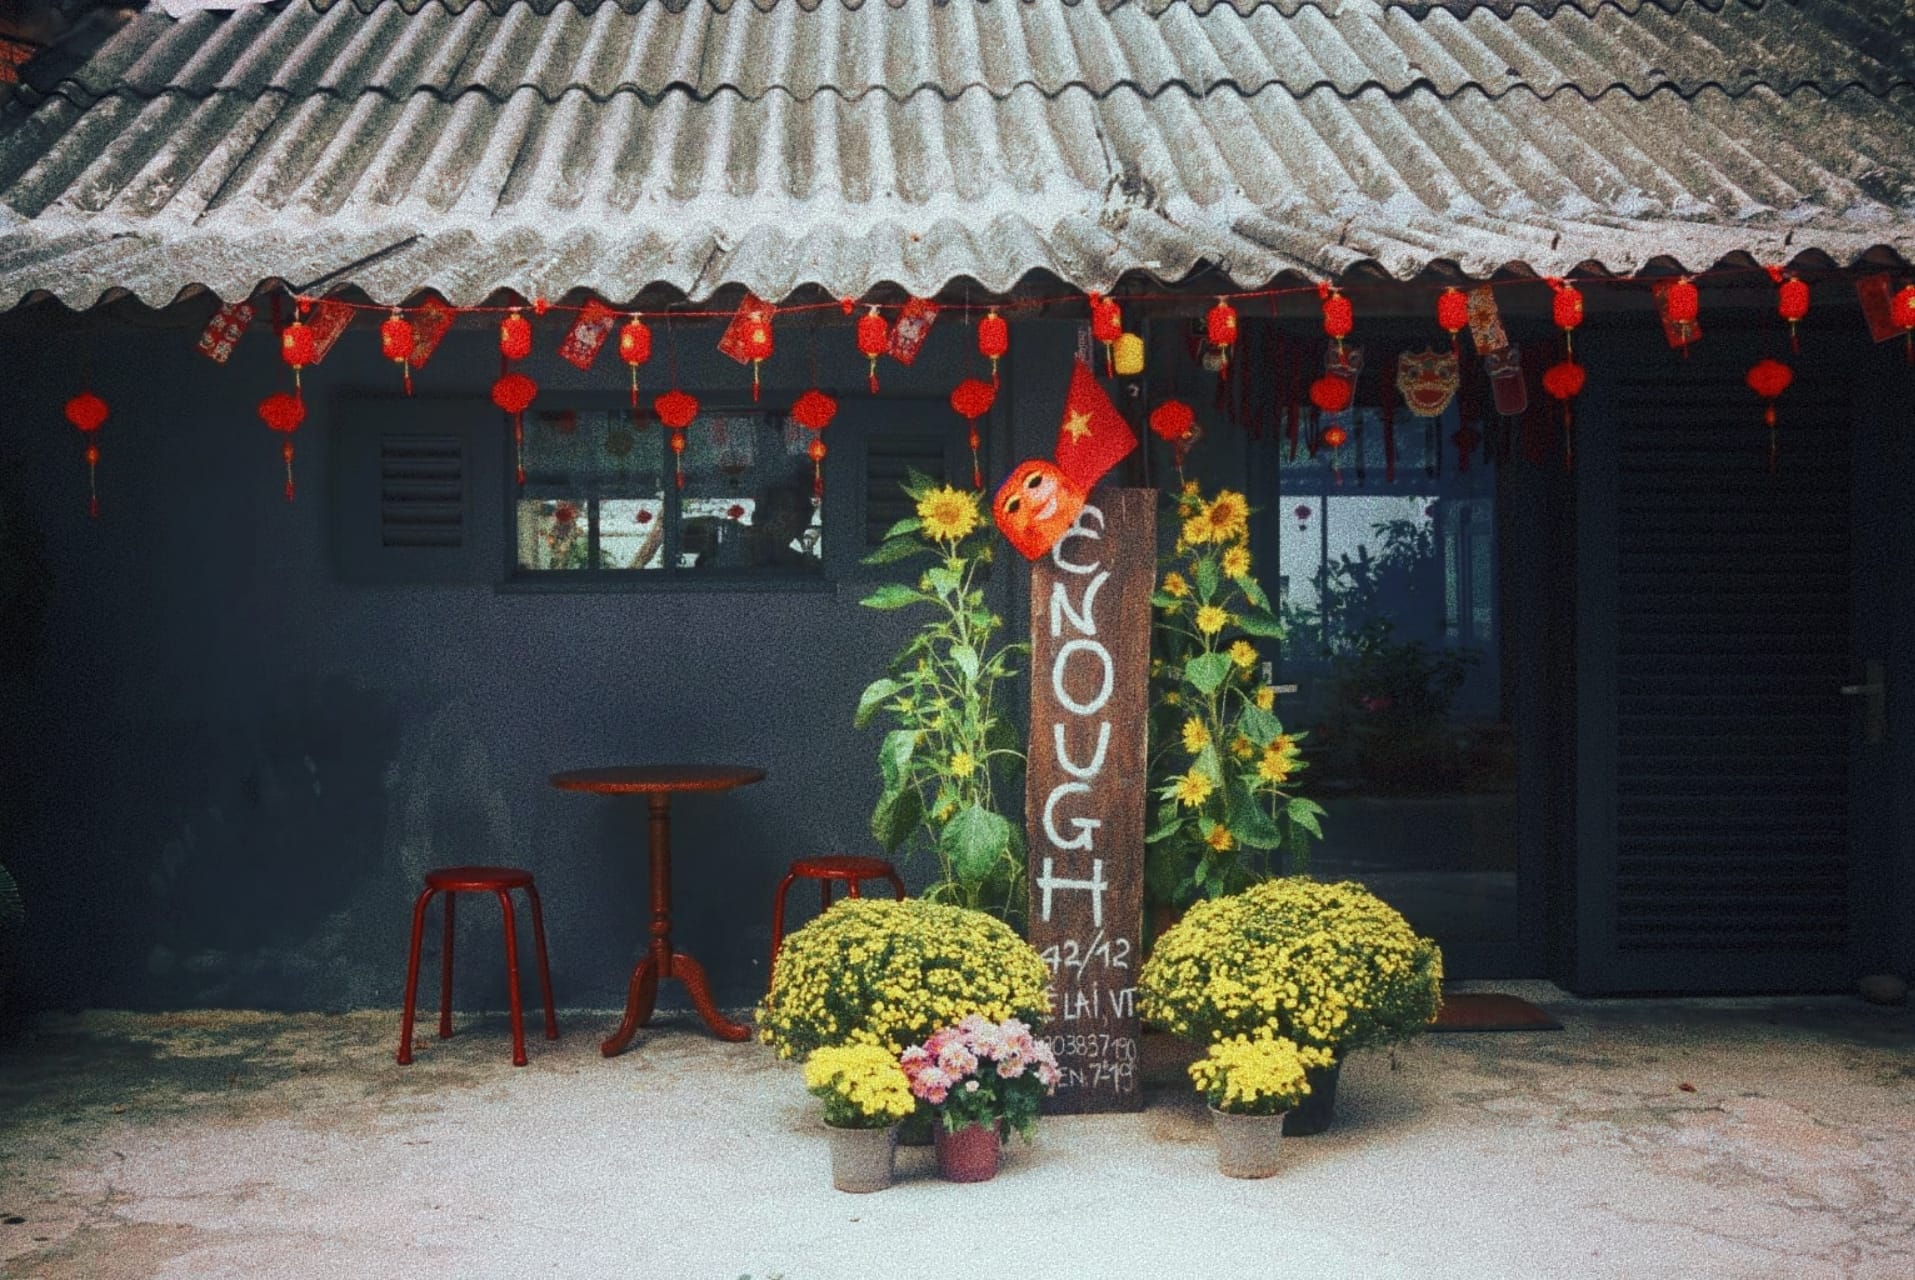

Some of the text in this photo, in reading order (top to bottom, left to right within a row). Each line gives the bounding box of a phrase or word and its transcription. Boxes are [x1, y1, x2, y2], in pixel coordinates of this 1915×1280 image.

[1036, 504, 1114, 927] ENOUGH
[1041, 929, 1130, 981] 42/12
[1111, 987, 1138, 1019] VT
